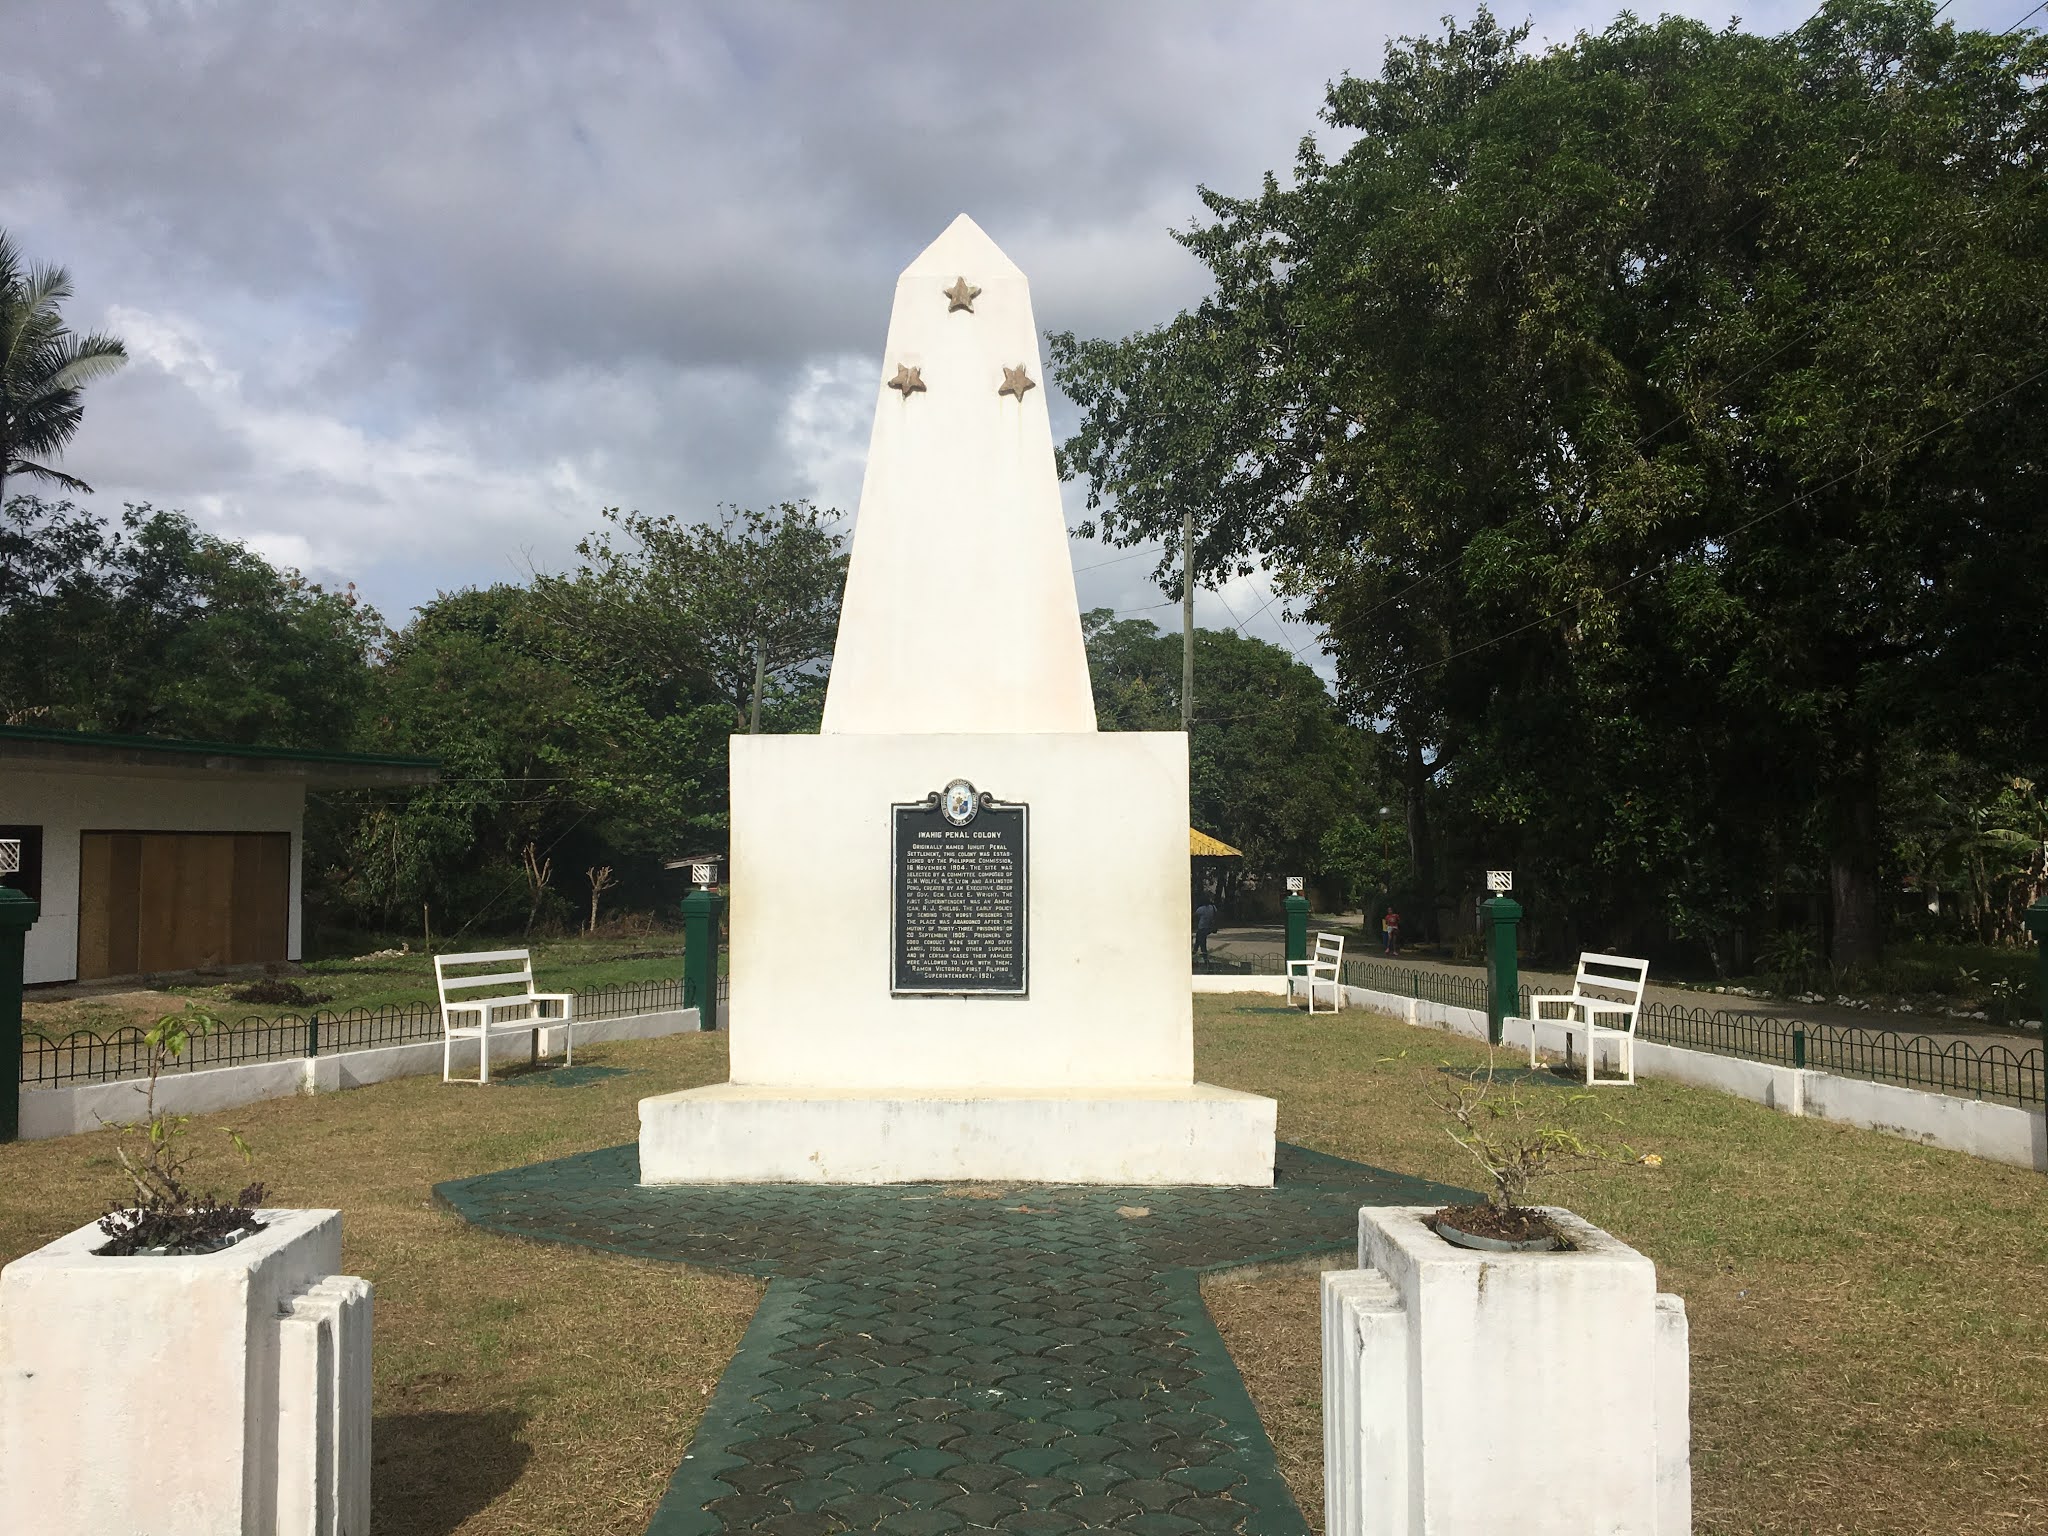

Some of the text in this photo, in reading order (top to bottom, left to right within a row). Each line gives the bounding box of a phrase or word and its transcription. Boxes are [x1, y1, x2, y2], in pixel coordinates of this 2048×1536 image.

[918, 831, 1002, 839] IWAHIG PENAL COLONY
